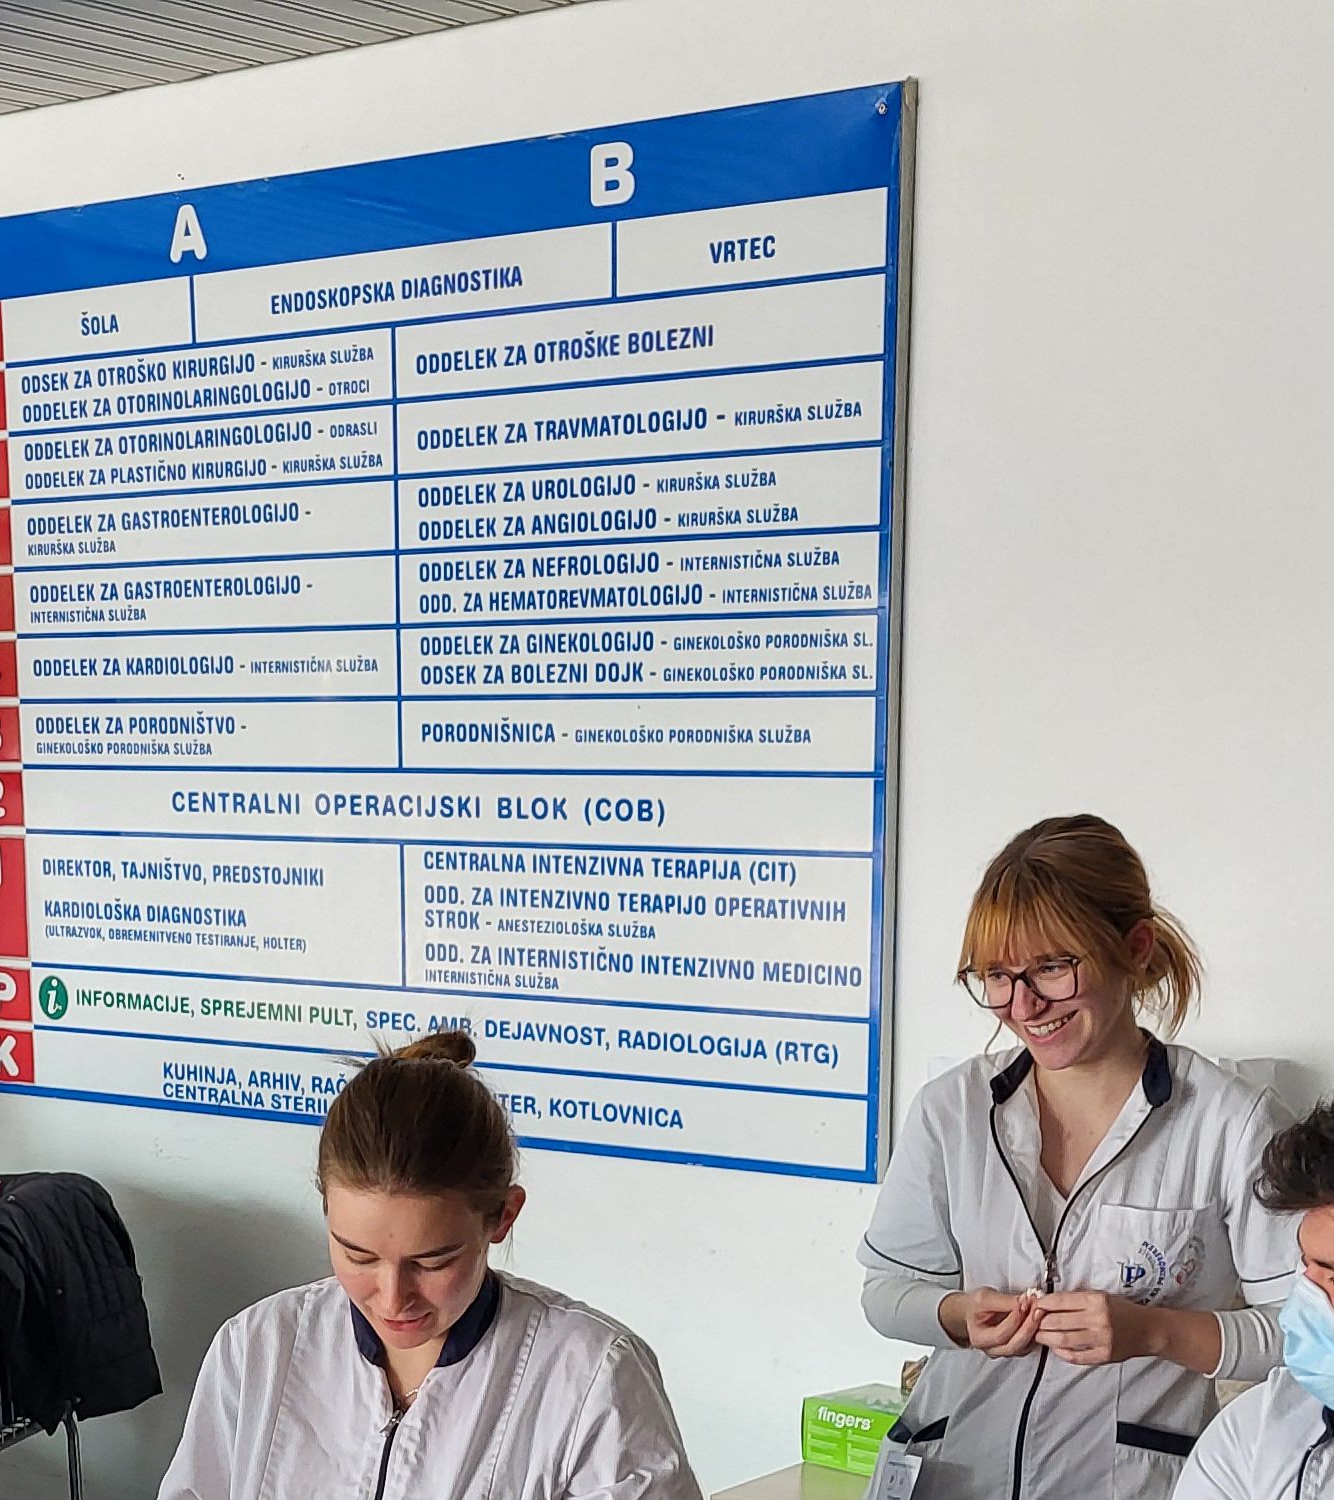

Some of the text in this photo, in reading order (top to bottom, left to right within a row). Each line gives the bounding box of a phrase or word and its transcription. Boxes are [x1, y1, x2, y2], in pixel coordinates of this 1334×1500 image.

[590, 142, 635, 207] B
[170, 204, 208, 263] A
[710, 236, 776, 263] VRTEC
[271, 266, 523, 315] ENDOSKOPSKA DIAGNOSTIKA
[81, 312, 119, 336] ŠOLA
[416, 325, 714, 375] ODDELEK ZA OTROŠKE BOLEZNI
[21, 347, 374, 394] ODSEK ZA OTROŠKO KIRURGIJO KIRURŠKA SLUŽBA
[417, 400, 862, 450] ODDELEK ZA TRAVMATOLOGIJO KIRURŠKA SLUŽBA
[33, 655, 378, 678] ODDELEK ZA KARDIOLOGIJO INTERNISTIČNA SLUŽBA
[172, 792, 665, 826] CENTRALNI OPERACIJSKI BLOK (COB)
[424, 852, 797, 886] CENTRALNA INTENZIVNA TERAPIJA (CIT)
[44, 898, 247, 927] KARDIOLOŠKA DIAGNOSTIKA
[45, 925, 306, 952] (ULTRAZVOK, OBREMENITVENO TESTIRANJE, HOLTER)
[76, 988, 196, 1017] INFORMACIJE,
[200, 998, 302, 1024] SPREJEMNI
[309, 1005, 358, 1030] PULT,
[367, 1010, 421, 1031] SPEC.
[485, 1019, 610, 1051] DEJAVNOST,
[618, 1030, 767, 1060] RADIOLOGIJA
[775, 1041, 839, 1068] (RTG)
[163, 1062, 242, 1088] KUHINJA,
[248, 1072, 305, 1095] ARHIV,
[549, 1098, 683, 1130] KOTLOVNICA
